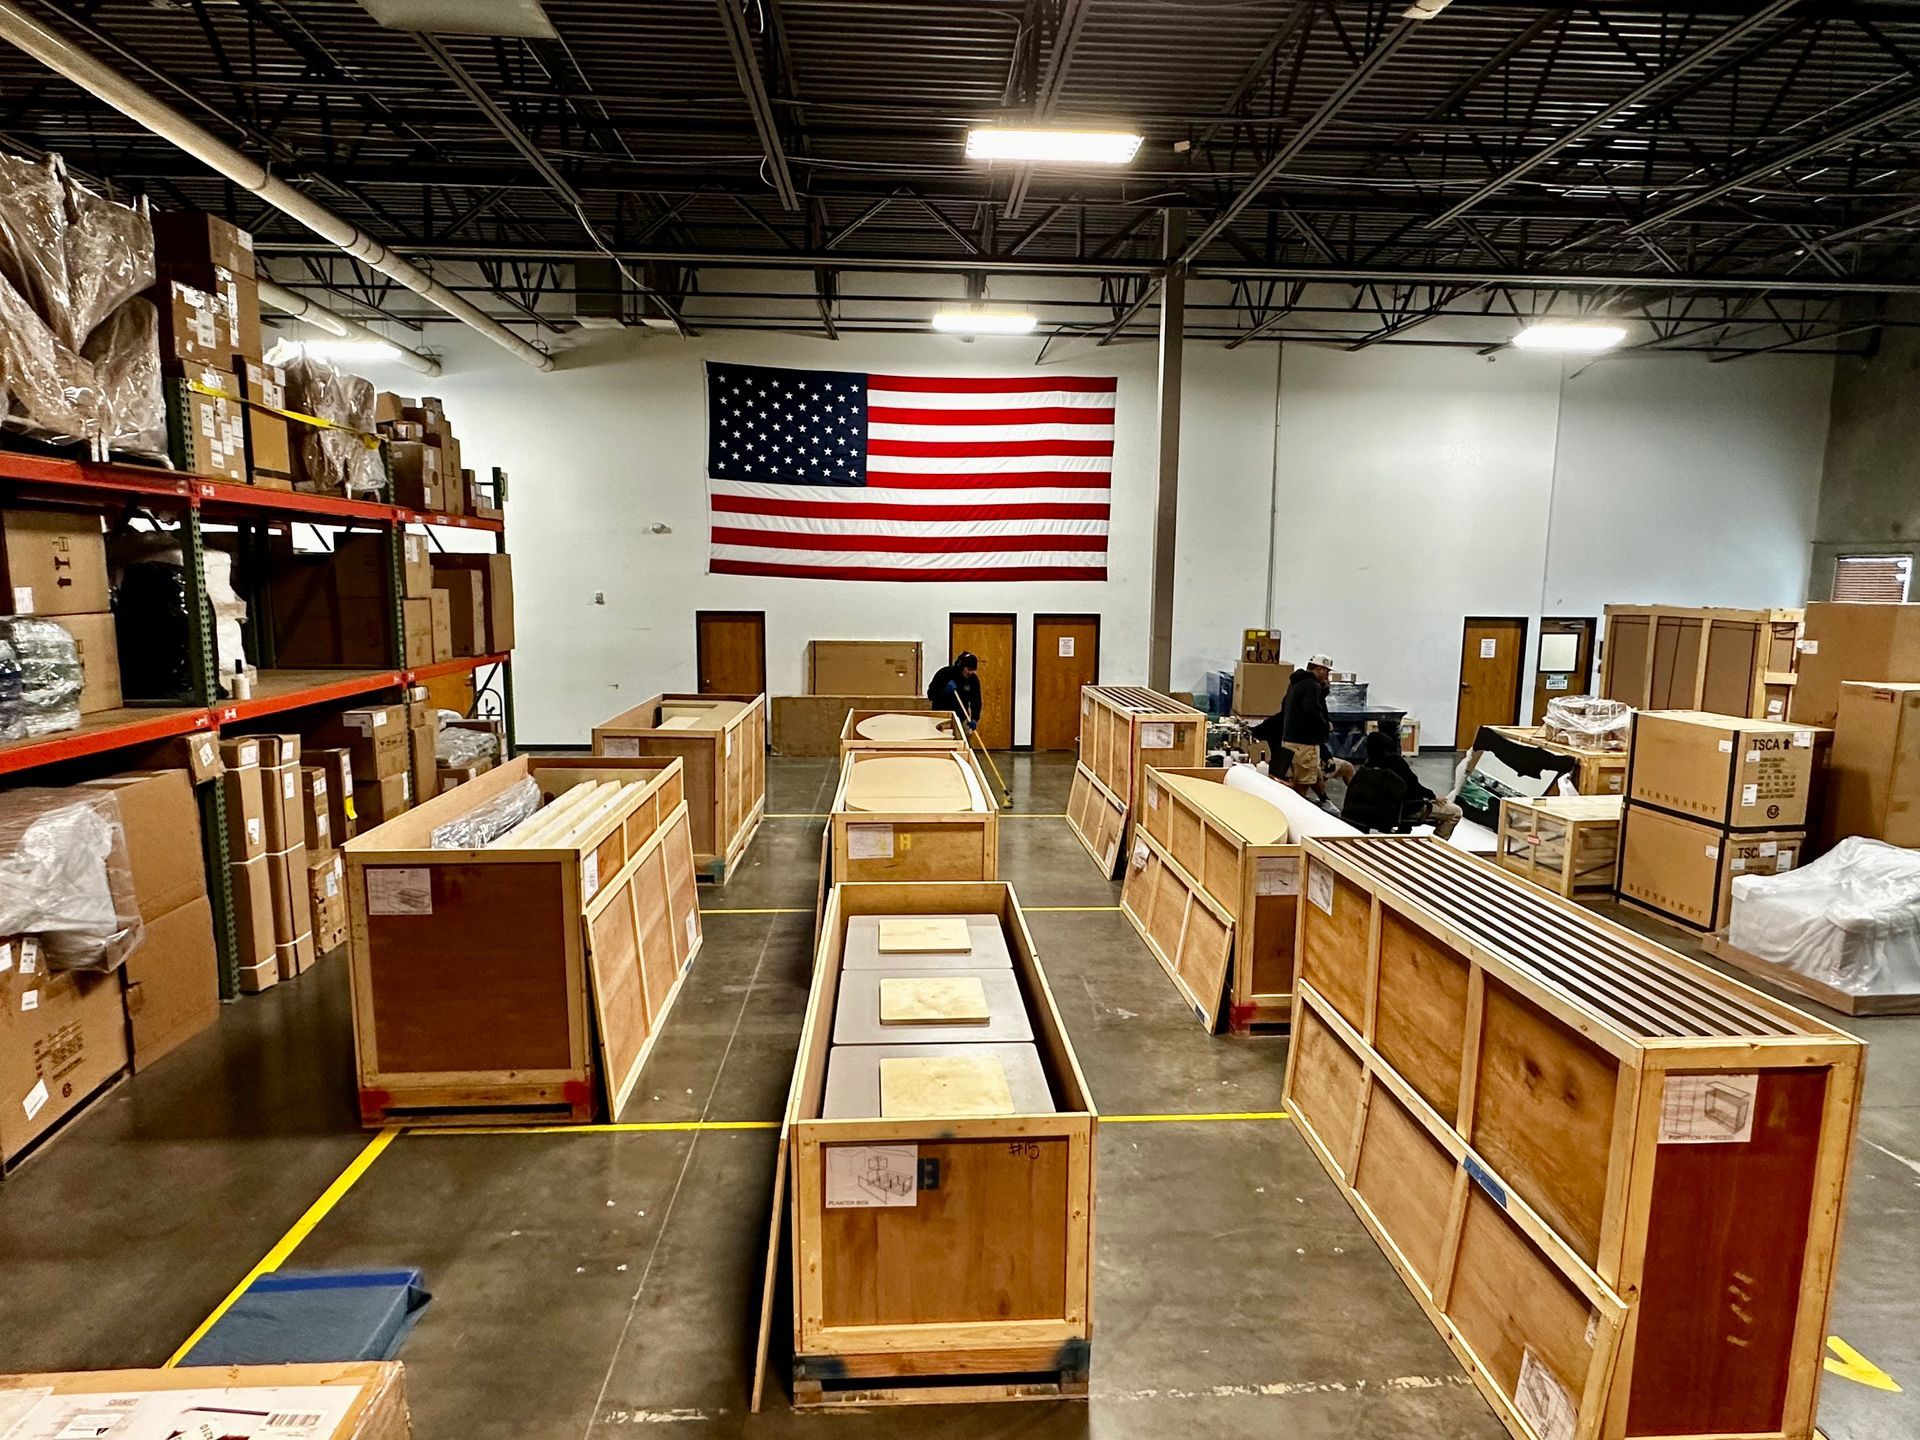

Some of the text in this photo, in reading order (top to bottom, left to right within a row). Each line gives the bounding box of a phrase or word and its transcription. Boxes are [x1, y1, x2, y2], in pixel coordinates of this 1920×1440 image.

[1752, 739, 1780, 751] TSCA
[1640, 788, 1717, 815] BERNHARDT
[1738, 847, 1761, 859] TSC
[1629, 883, 1703, 918] BERNHARDT
[1009, 1142, 1040, 1160] #15
